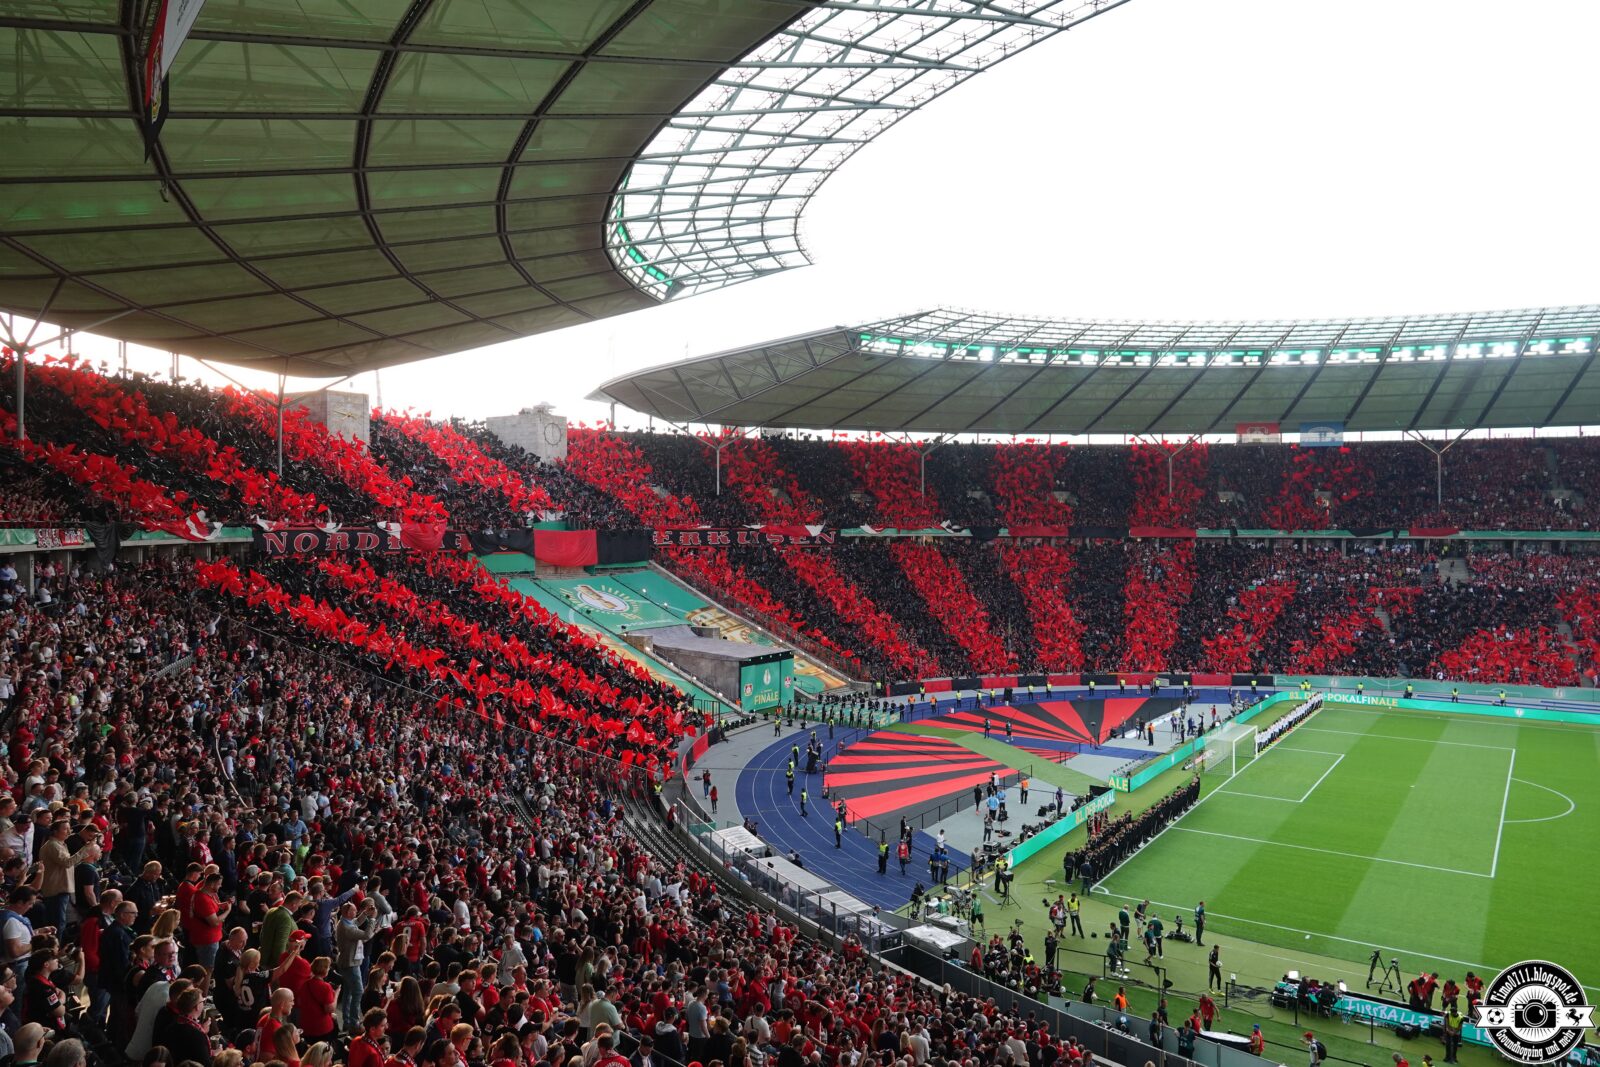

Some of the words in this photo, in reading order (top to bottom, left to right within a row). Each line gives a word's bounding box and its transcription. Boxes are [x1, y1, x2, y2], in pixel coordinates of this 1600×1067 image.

[653, 531, 836, 545] ERKUSEN
[754, 691, 779, 705] FINALE
[1304, 690, 1399, 706] D-POKALFINALE
[1343, 997, 1440, 1030] FUSSBALLZ
